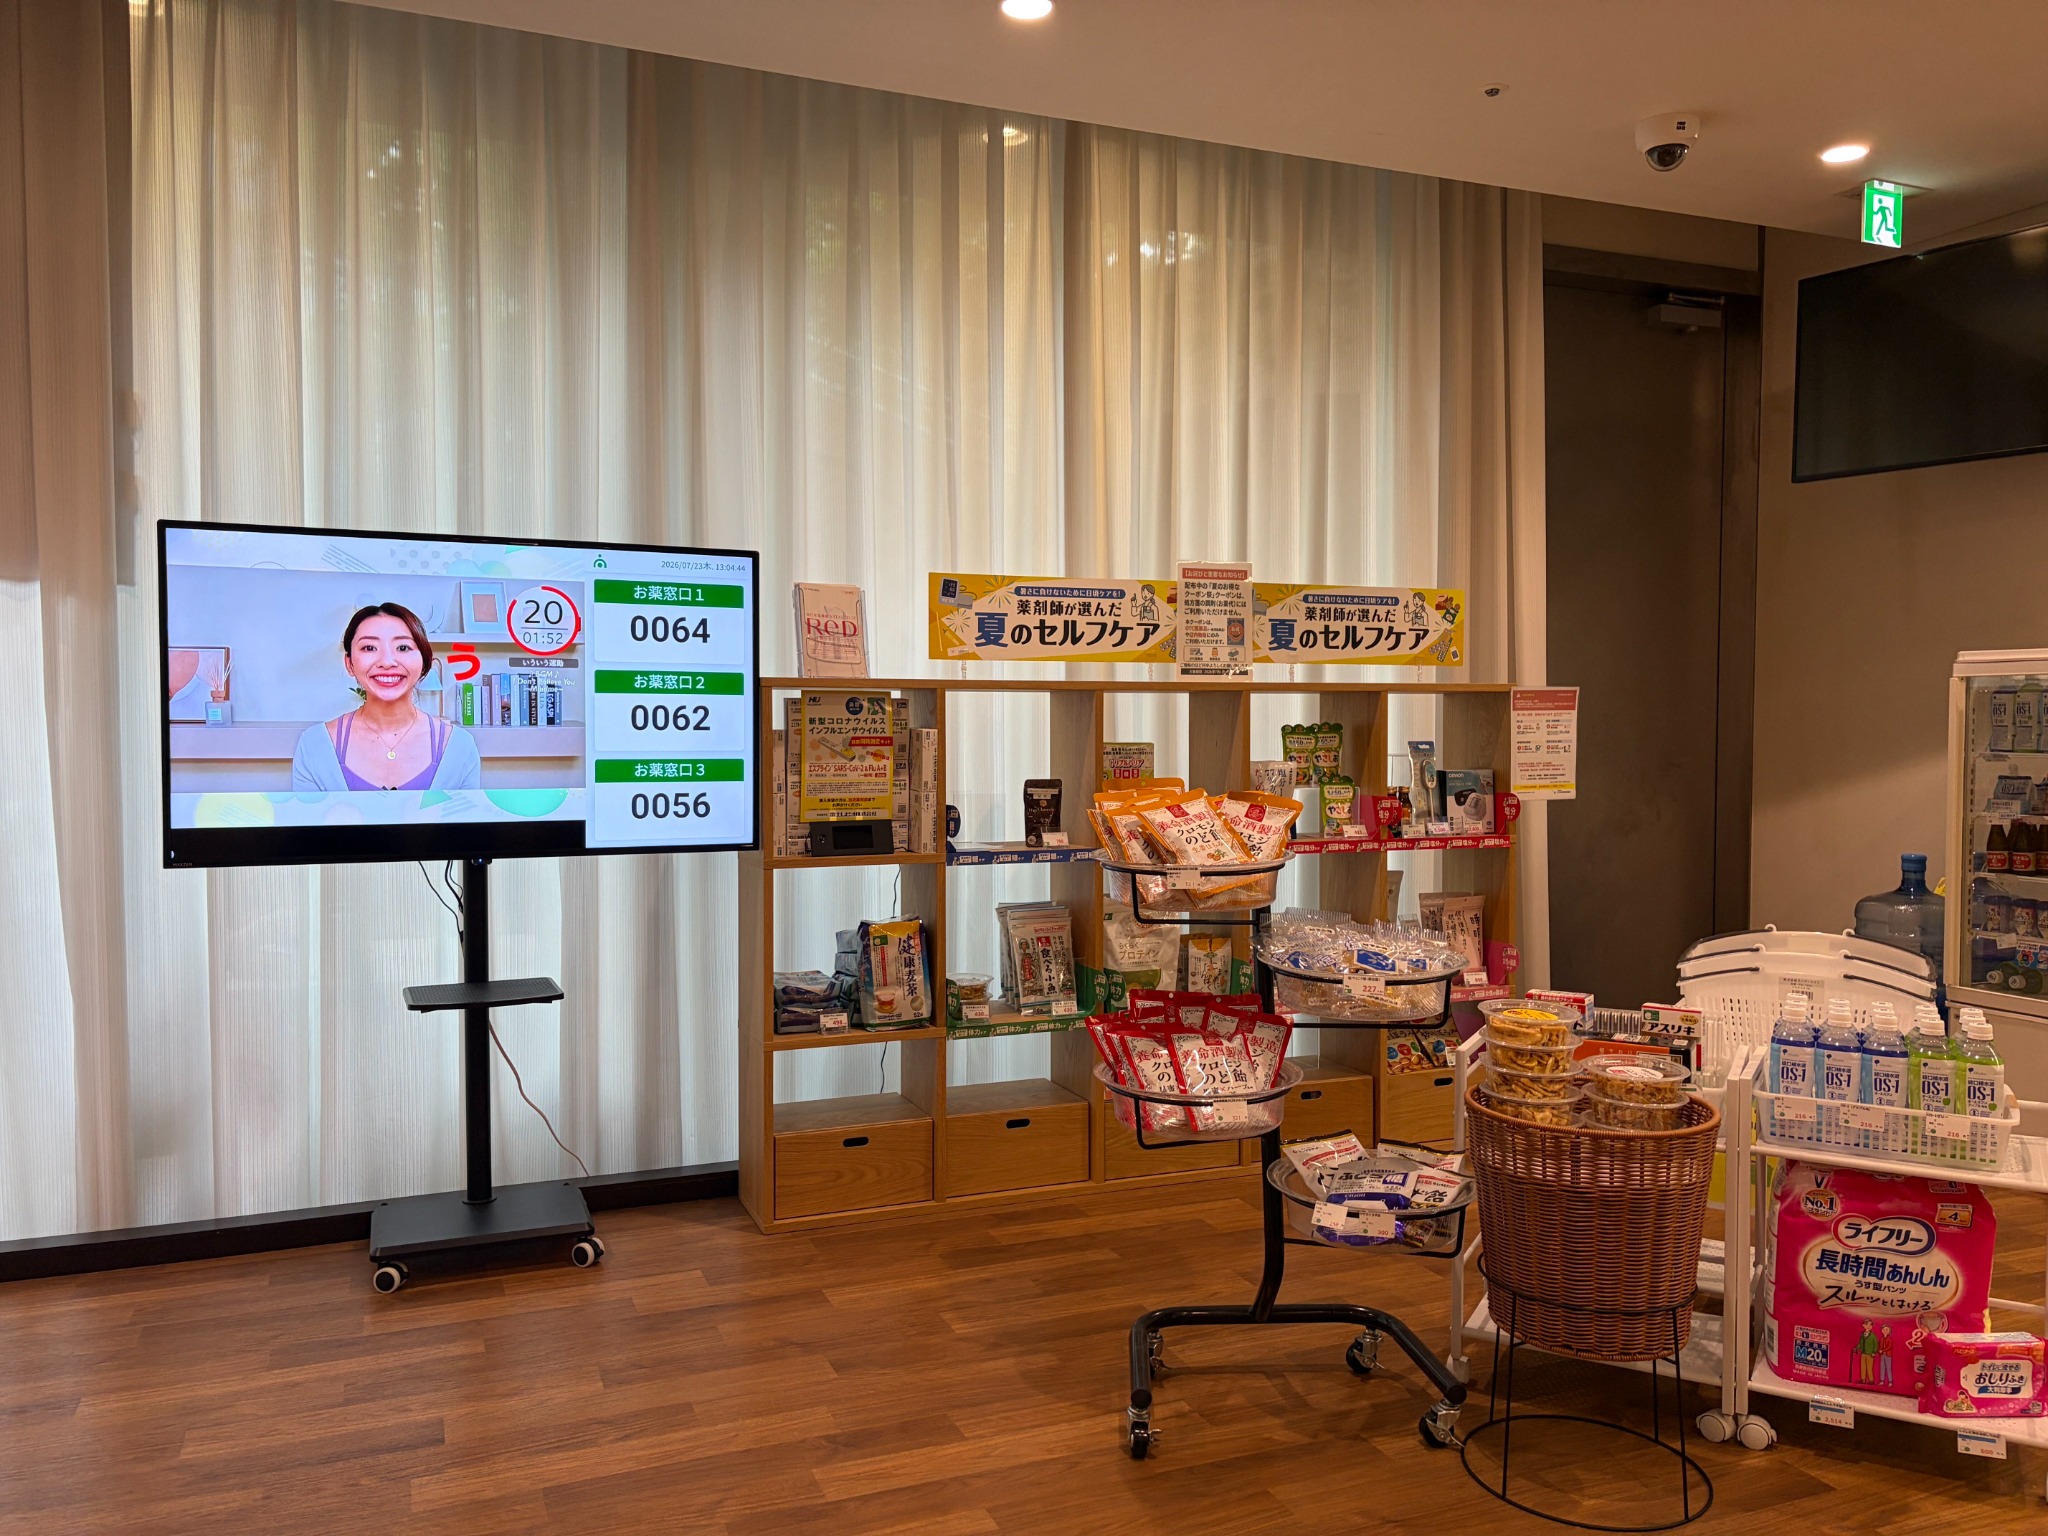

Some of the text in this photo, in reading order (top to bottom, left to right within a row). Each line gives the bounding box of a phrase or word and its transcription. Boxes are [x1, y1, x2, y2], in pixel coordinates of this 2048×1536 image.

[634, 585, 705, 601] お薬窓口1
[524, 599, 563, 625] 20
[1016, 599, 1123, 617] 薬剤師が選んだ
[1304, 606, 1397, 623] 薬剤師が選んだ
[630, 615, 711, 643] 0064
[974, 611, 1161, 648] 夏のセルフケア
[1268, 618, 1430, 652] 夏のセルフケア
[522, 632, 564, 644] 01:52
[446, 642, 481, 681] う
[634, 674, 705, 689] お薬窓口2
[631, 704, 711, 731] 0062
[808, 716, 886, 726] 新型コロナウイルス
[808, 726, 887, 735] インフルエンザウイルス
[1314, 754, 1339, 763] やさしお
[634, 763, 705, 778] お薬窓口3
[631, 792, 711, 819] 0056
[1177, 820, 1215, 838] クロモジ
[1118, 949, 1160, 961] プロテイン
[897, 933, 918, 997] 健康麦茶
[1040, 947, 1057, 993] 食べる小魚
[1362, 985, 1377, 993] 227
[1781, 1066, 1807, 1082] OS-1
[1826, 1066, 1851, 1074] 経口補水液
[1874, 1071, 1900, 1079] 経口補水液
[1922, 1074, 1949, 1082] 経口補水液
[1826, 1072, 1851, 1088] OS-1
[1874, 1077, 1900, 1093] OS-1
[1922, 1081, 1949, 1097] OS-1
[1967, 1086, 1995, 1102] OS-1
[1803, 1195, 1836, 1210] No.1
[1844, 1222, 1924, 1247] ライフリー
[1815, 1248, 1950, 1289] 長時間あんしん
[1854, 1279, 1907, 1294] うす型パンツ
[1975, 1372, 2025, 1385] おしりふき
